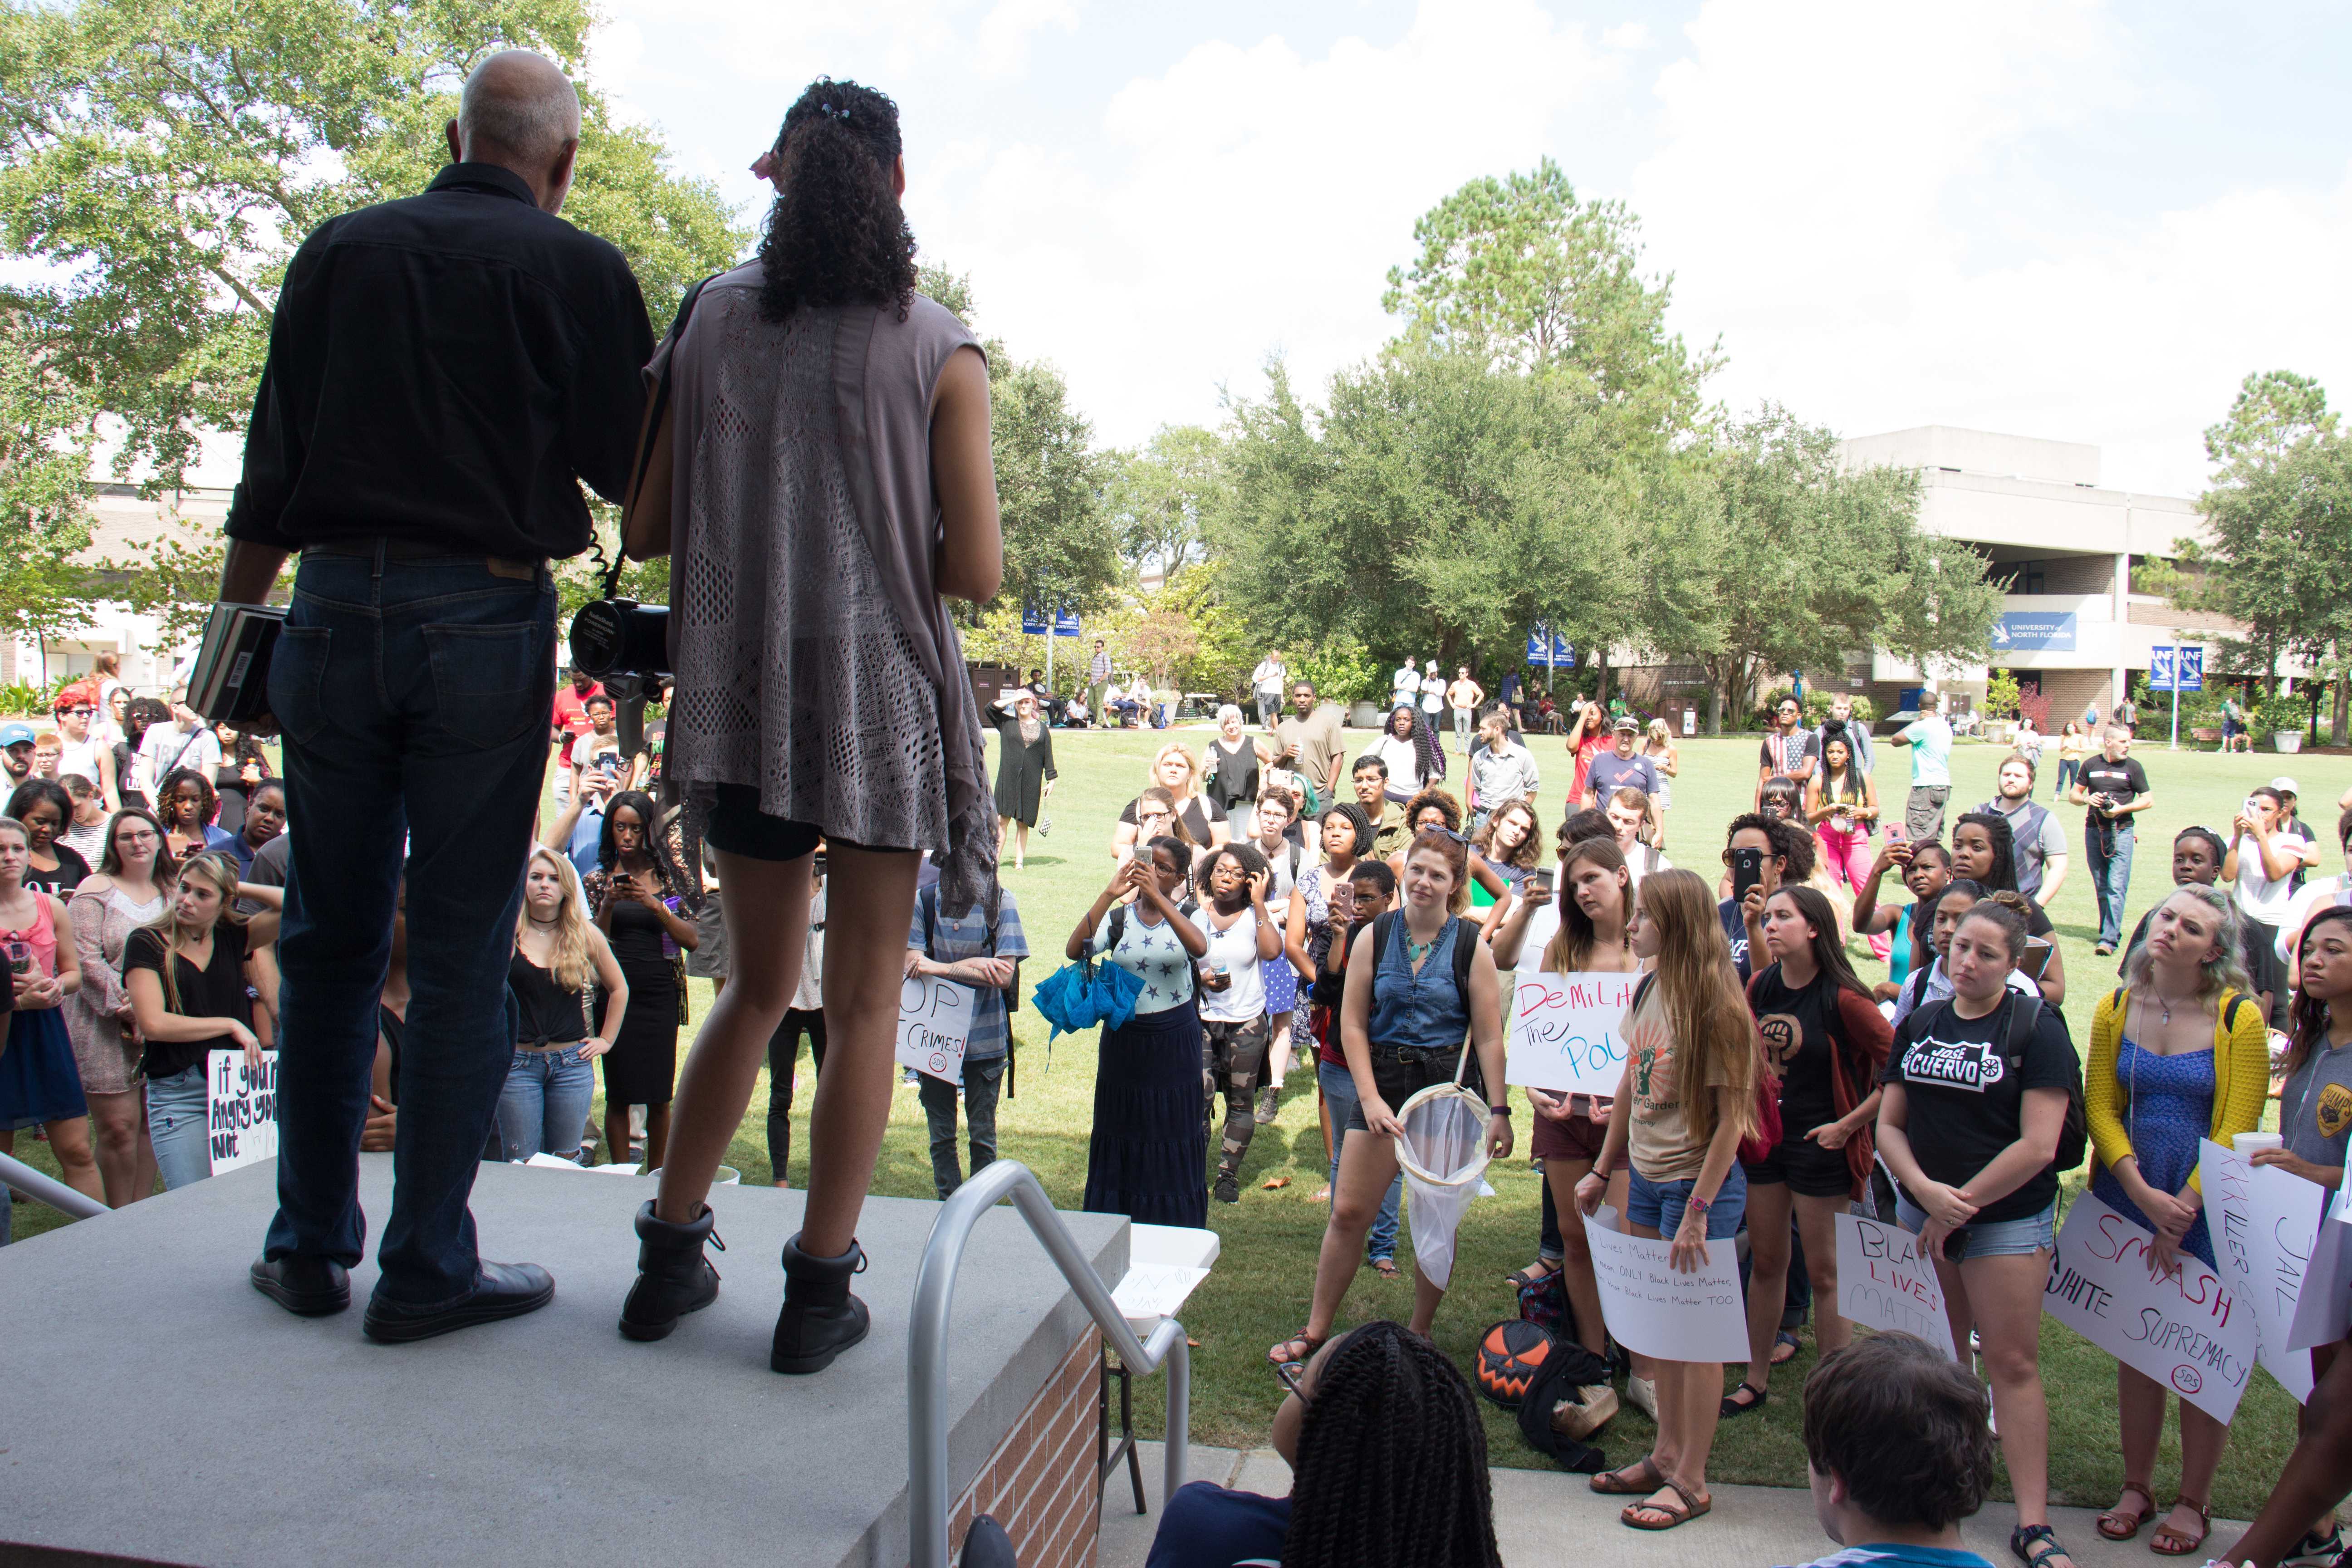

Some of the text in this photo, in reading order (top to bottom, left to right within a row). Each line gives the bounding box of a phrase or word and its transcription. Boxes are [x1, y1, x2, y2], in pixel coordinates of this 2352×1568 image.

[2152, 650, 2173, 660] UNF
[2180, 651, 2201, 661] UNF
[908, 1023, 966, 1058] CRIMES!
[1514, 1017, 1569, 1046] The
[931, 1058, 944, 1067] SDS
[1931, 1047, 1967, 1059] JOSE
[219, 1055, 231, 1094] if
[1910, 1053, 1978, 1083] CUERVO
[211, 1098, 251, 1130] Angry
[1599, 1232, 1622, 1254] Lives
[1628, 1243, 1670, 1262] Matter
[1600, 1260, 1732, 1288] mean ONLY Black Lives Matter,
[2085, 1214, 2231, 1328] SMASH
[1624, 1286, 1643, 1298] Black
[1647, 1294, 1666, 1303] Lives
[1672, 1296, 1702, 1306] Matter
[1707, 1295, 1734, 1306] TOO
[1870, 1261, 1937, 1312] LIVES
[2122, 1307, 2246, 1387] SUPREMACY
[2176, 1369, 2199, 1387] SDS
